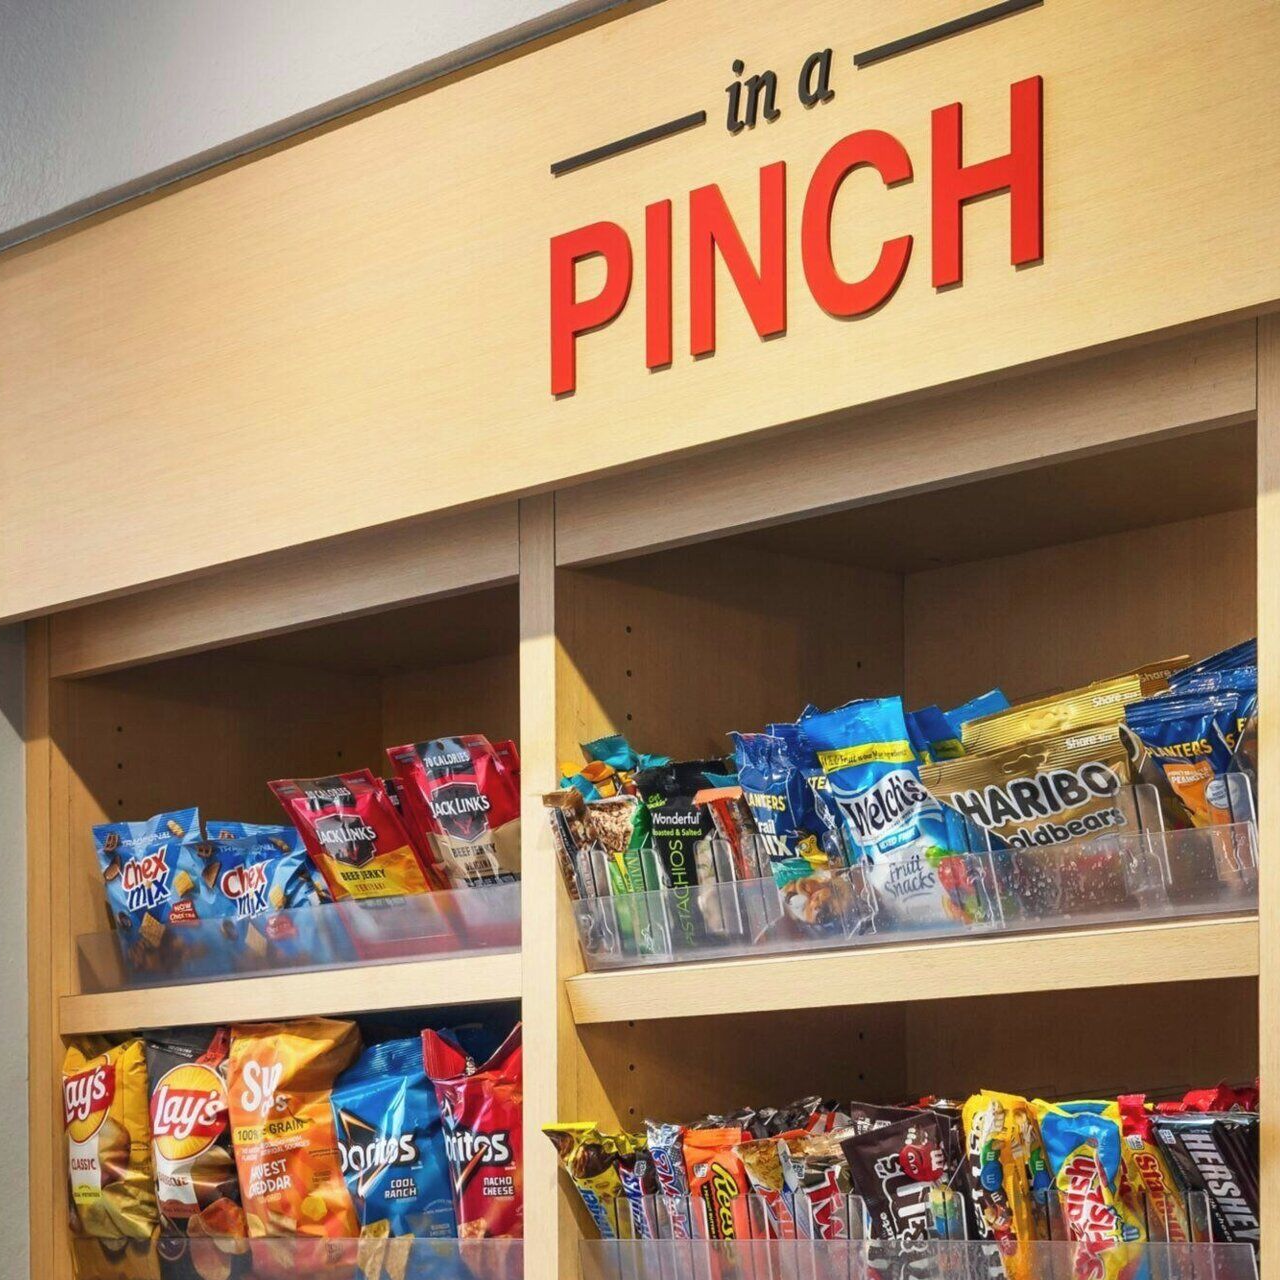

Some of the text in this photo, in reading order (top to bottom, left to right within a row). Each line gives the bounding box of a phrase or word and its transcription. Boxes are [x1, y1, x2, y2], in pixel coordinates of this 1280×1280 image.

[725, 48, 836, 134] in a
[549, 74, 1045, 397] PINCH
[1144, 739, 1213, 759] PLANTERS
[431, 794, 491, 818] JACK LINK'S
[839, 774, 928, 838] Welch's
[959, 764, 1120, 830] HARIBO
[651, 811, 700, 826] Wonderful
[1009, 807, 1127, 852] oldbears
[318, 825, 378, 846] JACK LINK'S
[122, 845, 169, 891] Chex
[222, 861, 269, 898] Chex
[341, 868, 387, 881] BEEF JERKY
[888, 853, 924, 884] Fruit
[129, 874, 170, 911] mix
[883, 869, 937, 900] Snacks
[238, 884, 268, 919] mix
[153, 1085, 226, 1140] Lay's
[269, 1120, 305, 1136] GRAIN
[445, 1131, 511, 1163] ritos
[384, 1188, 418, 1199] RANCH
[390, 1178, 415, 1189] COOL
[482, 1185, 515, 1197] CHEESE
[483, 1176, 513, 1187] NACHO
